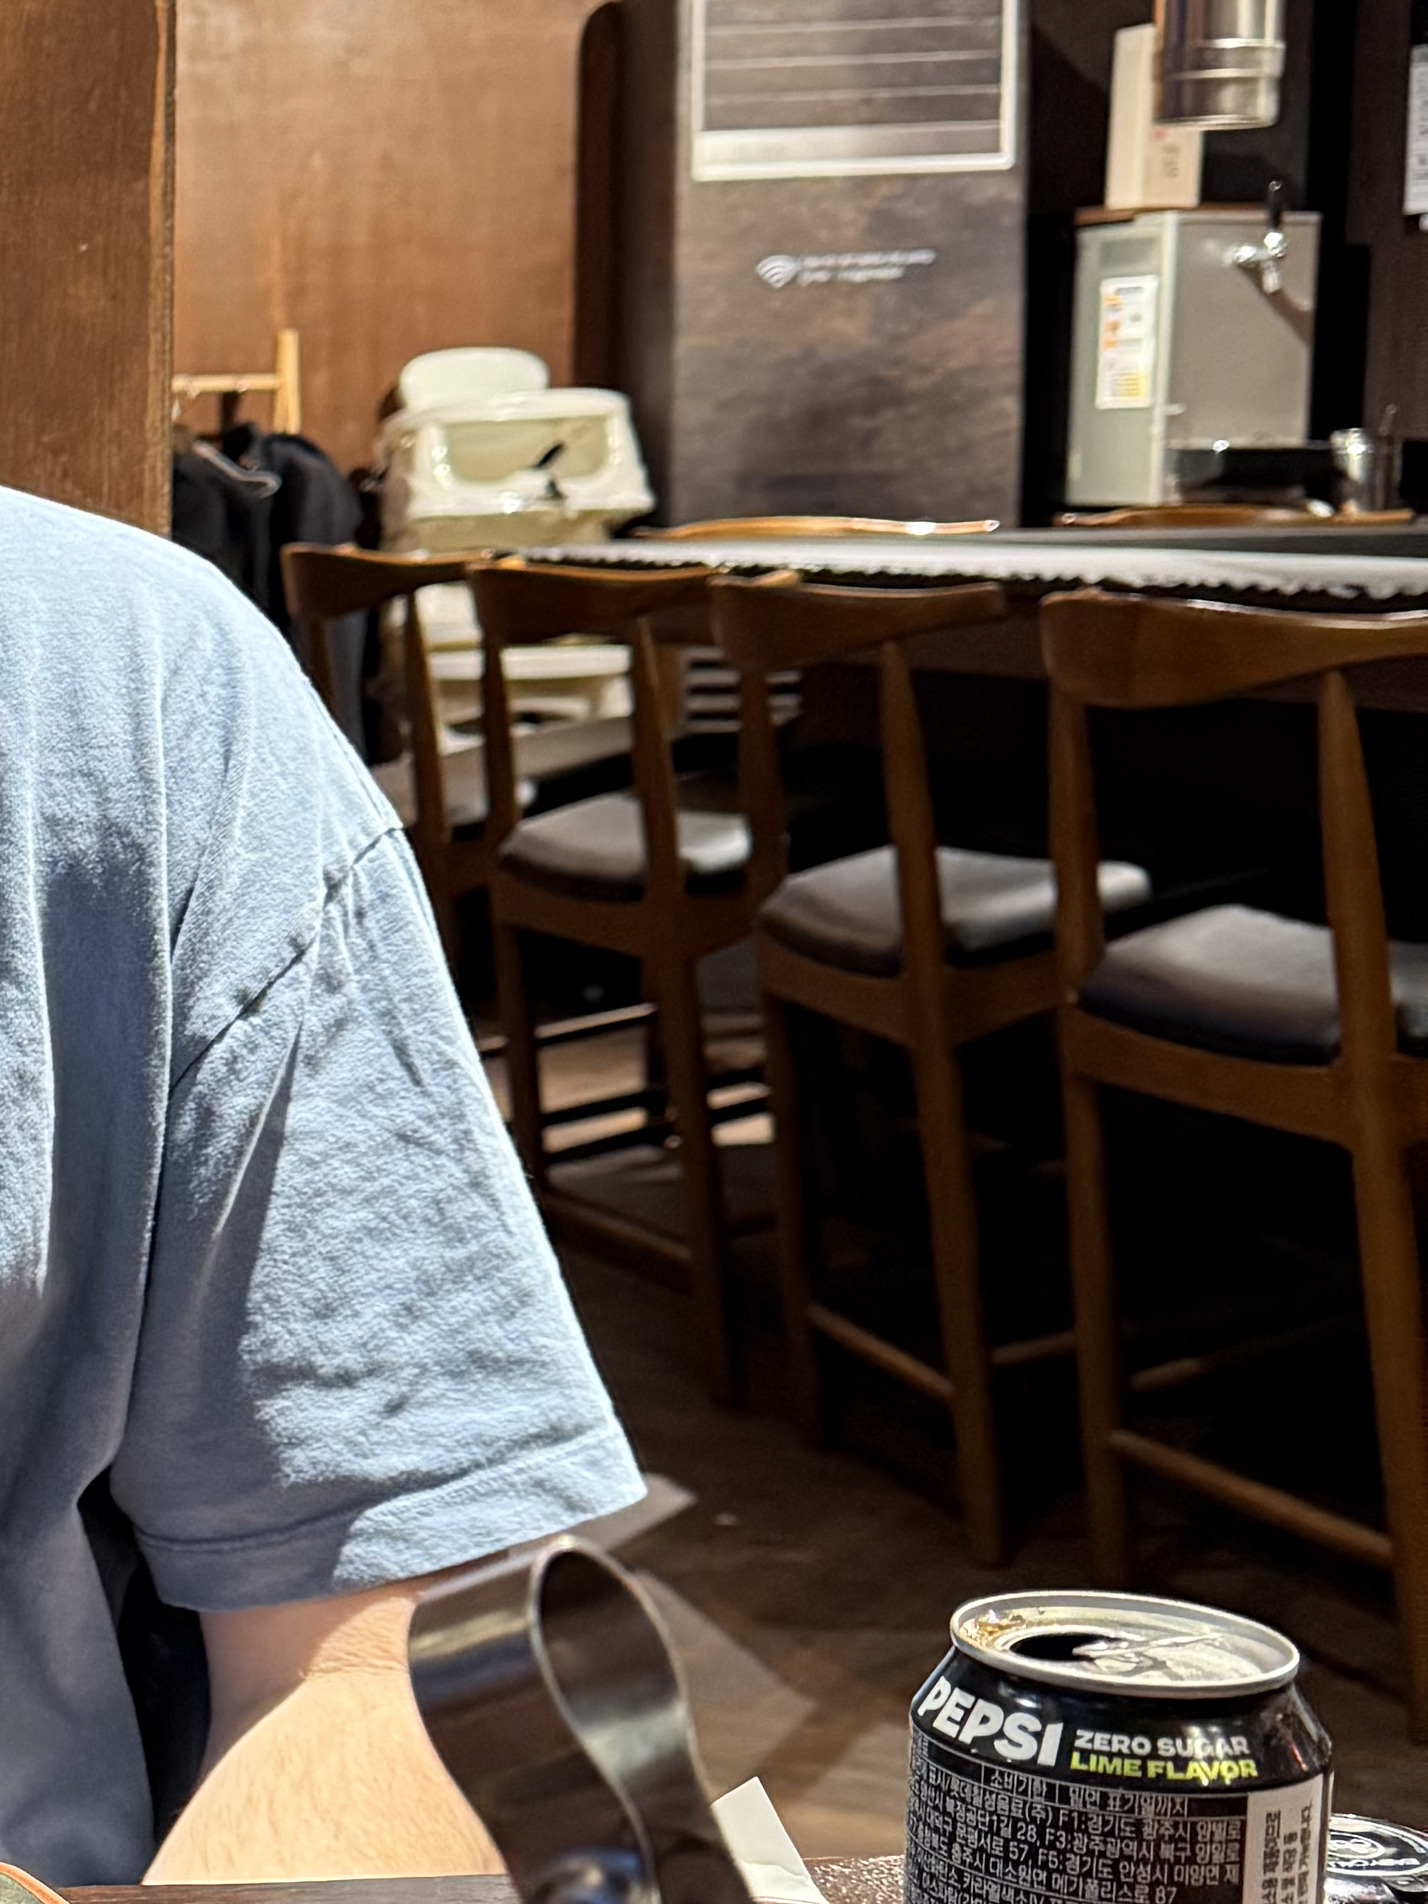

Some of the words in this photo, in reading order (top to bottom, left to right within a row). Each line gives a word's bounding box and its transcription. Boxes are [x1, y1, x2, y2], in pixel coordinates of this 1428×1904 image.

[916, 1675, 1065, 1767] PEPSI
[1074, 1729, 1152, 1757] ZERO
[1157, 1735, 1252, 1760] SUGAR
[1070, 1751, 1142, 1779] LIME
[1147, 1759, 1259, 1784] FLAVOR
[990, 1770, 1048, 1802] 소비기한
[1154, 1885, 1178, 1904] 87
